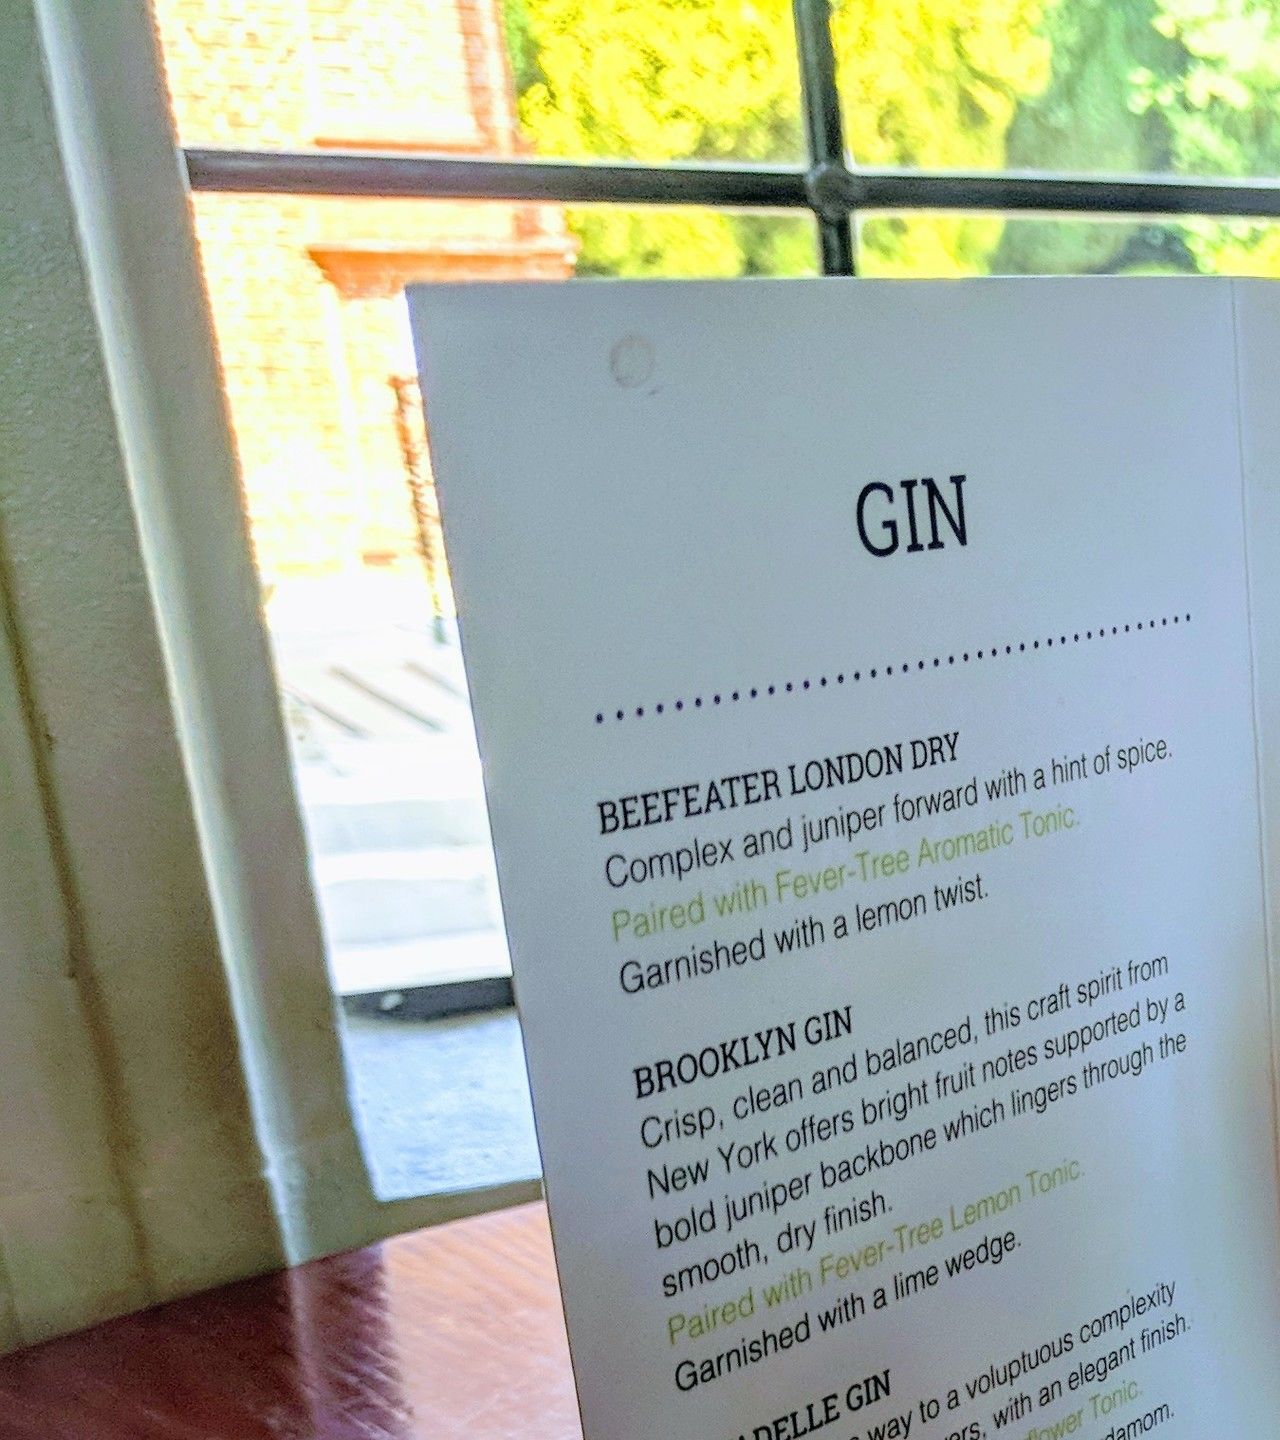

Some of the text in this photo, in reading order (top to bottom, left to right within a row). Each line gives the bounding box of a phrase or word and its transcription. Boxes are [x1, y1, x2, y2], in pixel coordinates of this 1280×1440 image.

[855, 474, 968, 558] GIN
[596, 731, 960, 835] BEEFEATER LONDON DRY
[605, 739, 1173, 888] Complex and juniper forward with a hint of spice.
[611, 803, 1080, 943] Paired with Fever-Tree Aromatic Tonic.
[619, 873, 989, 994] Garnished with a lemon twist.
[632, 1005, 852, 1099] BROOKLYN GIN
[640, 955, 1169, 1149] Crisp, clean and balanced, this craft spirit from
[662, 1190, 893, 1298] smooth, dry finish.
[845, 1368, 891, 1412] GIN
